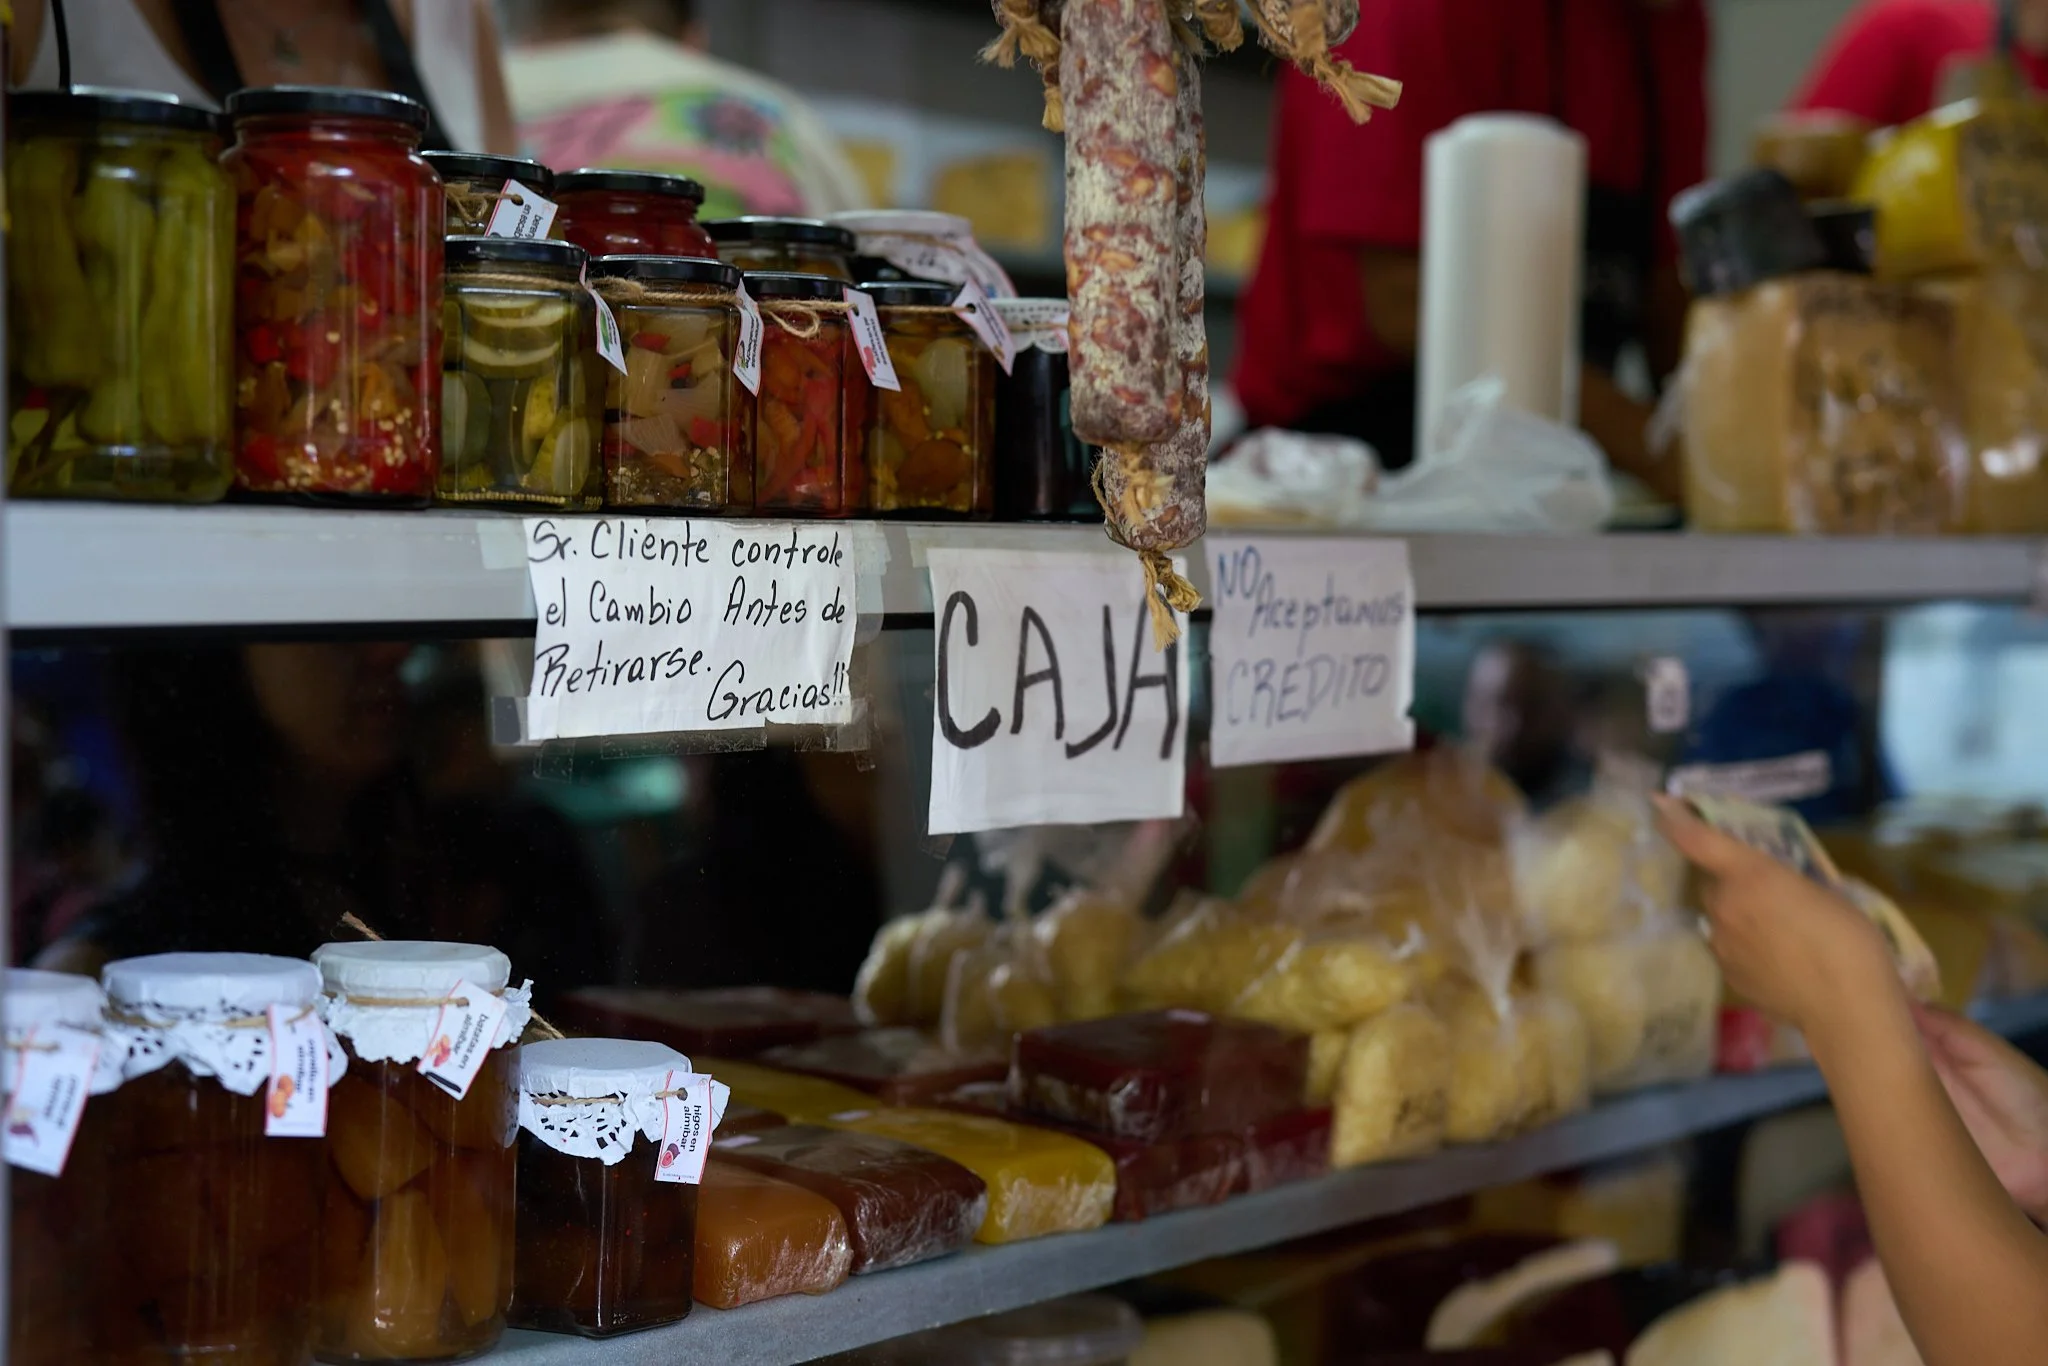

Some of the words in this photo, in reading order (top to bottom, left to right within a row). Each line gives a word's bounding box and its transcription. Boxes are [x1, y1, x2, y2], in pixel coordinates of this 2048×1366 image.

[513, 214, 528, 239] escab
[523, 203, 532, 215] en
[525, 214, 544, 239] berenj
[527, 520, 577, 562] Sr.
[591, 520, 710, 567] Cliente
[731, 527, 844, 568] controle
[1217, 545, 1261, 609] NO
[546, 577, 566, 627] el
[589, 580, 692, 626] Cambio
[723, 576, 807, 627] Antes
[822, 586, 845, 624] de
[536, 640, 711, 697] Retirarse.
[707, 660, 846, 721] Gracias!!
[937, 590, 1179, 760] CAJA
[1227, 653, 1392, 729] CREDITO
[468, 1013, 490, 1053] batatas
[458, 1054, 470, 1069] en
[692, 1105, 702, 1137] higos
[689, 1137, 698, 1152] en
